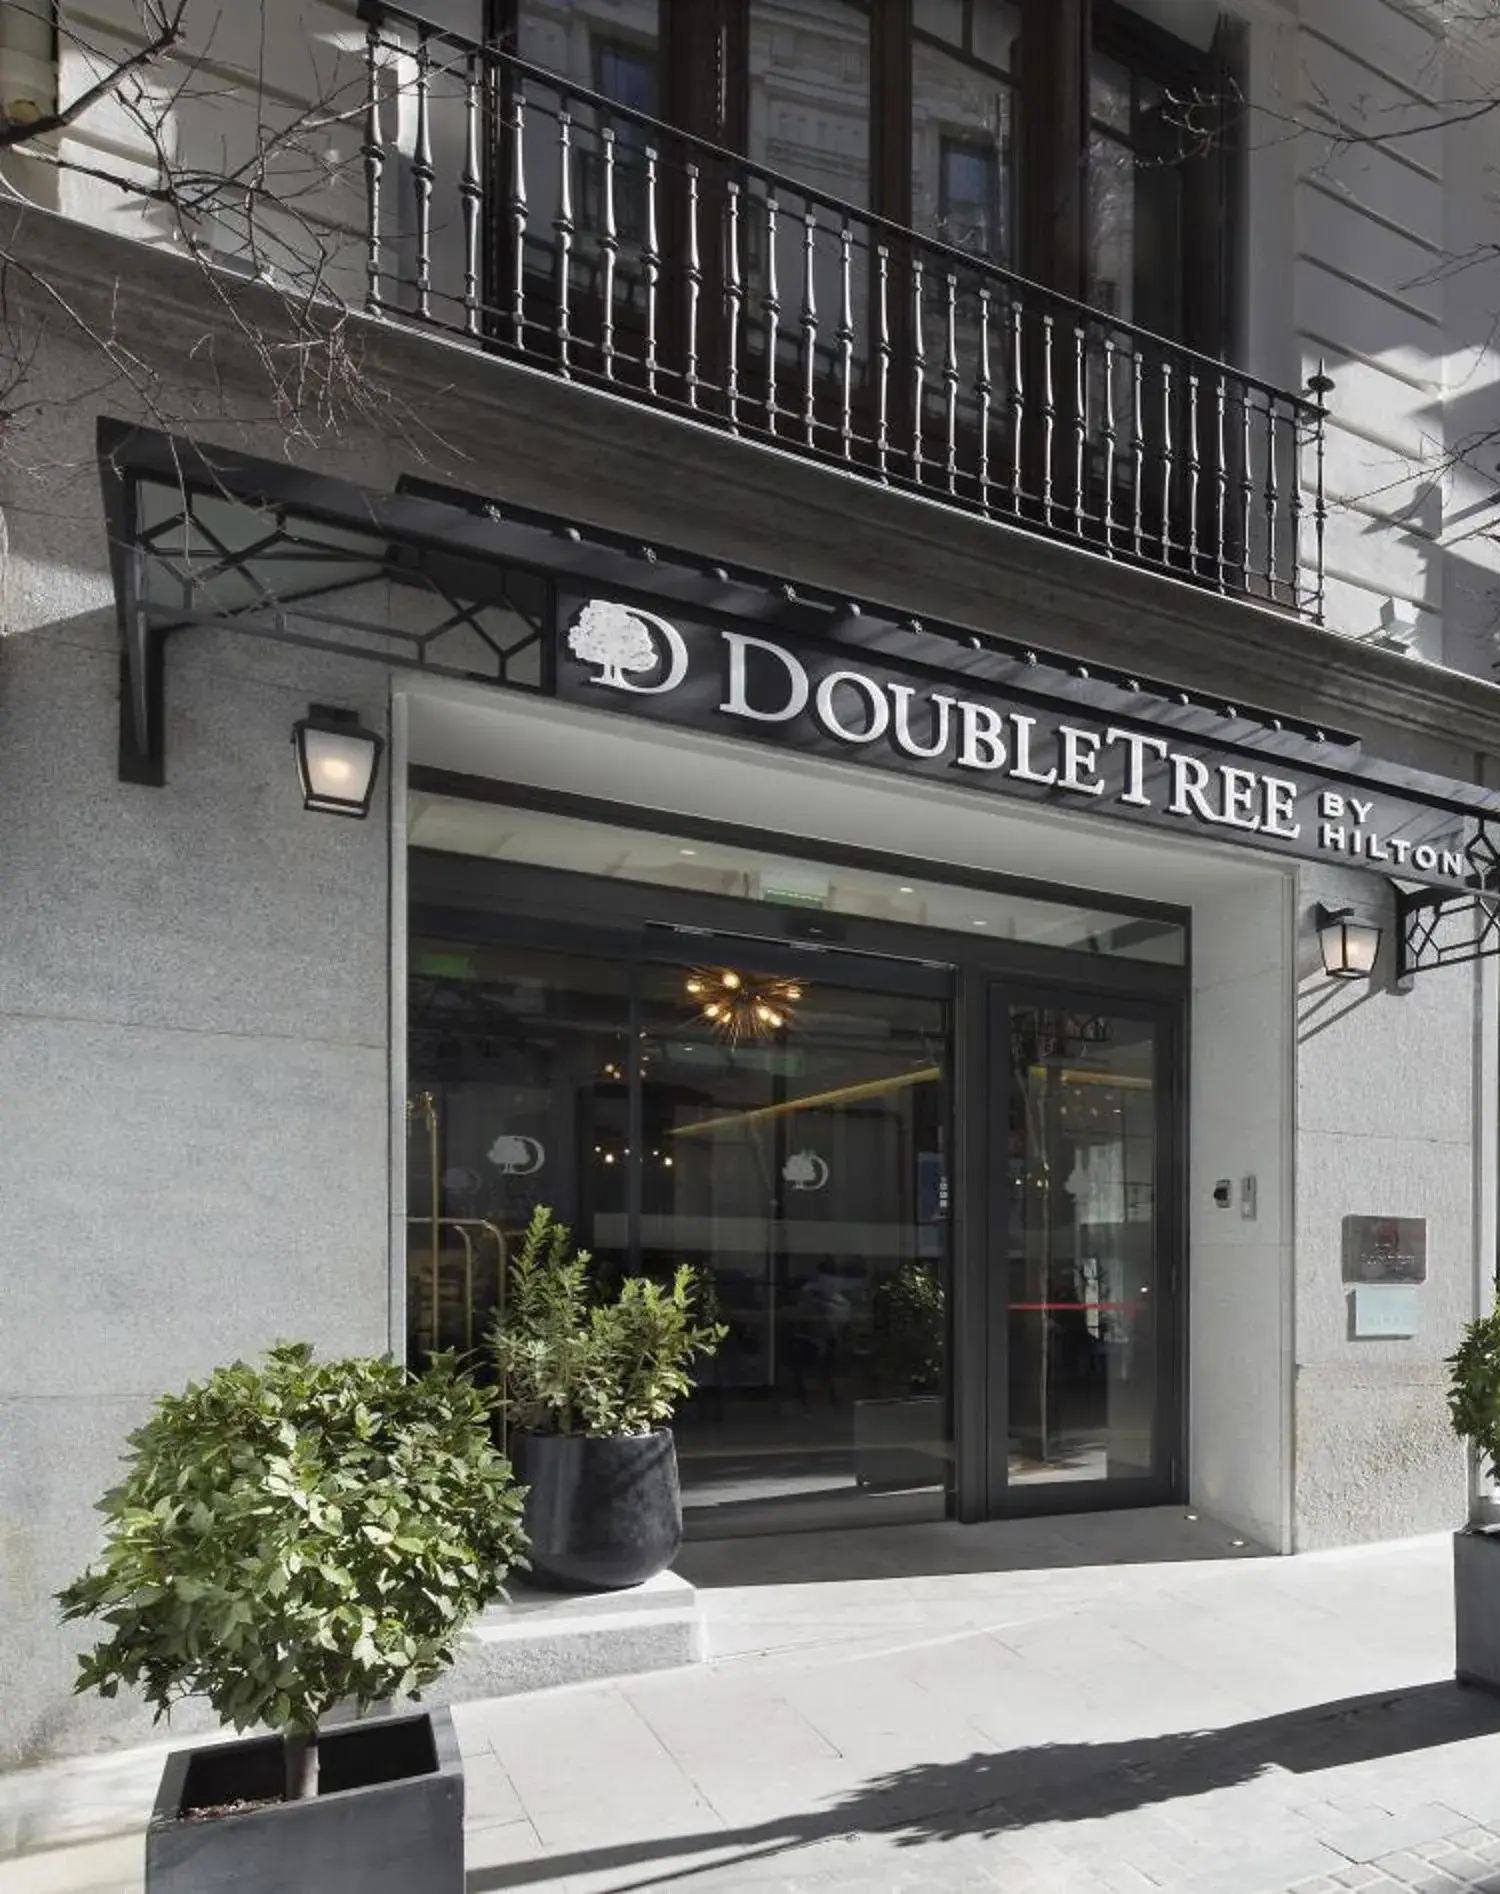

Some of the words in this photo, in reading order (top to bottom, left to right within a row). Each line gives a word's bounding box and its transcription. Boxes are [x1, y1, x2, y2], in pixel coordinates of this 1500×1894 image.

[719, 630, 1301, 840] DOUBLETREE
[1321, 791, 1375, 824] BY
[1322, 824, 1464, 877] HILTON
